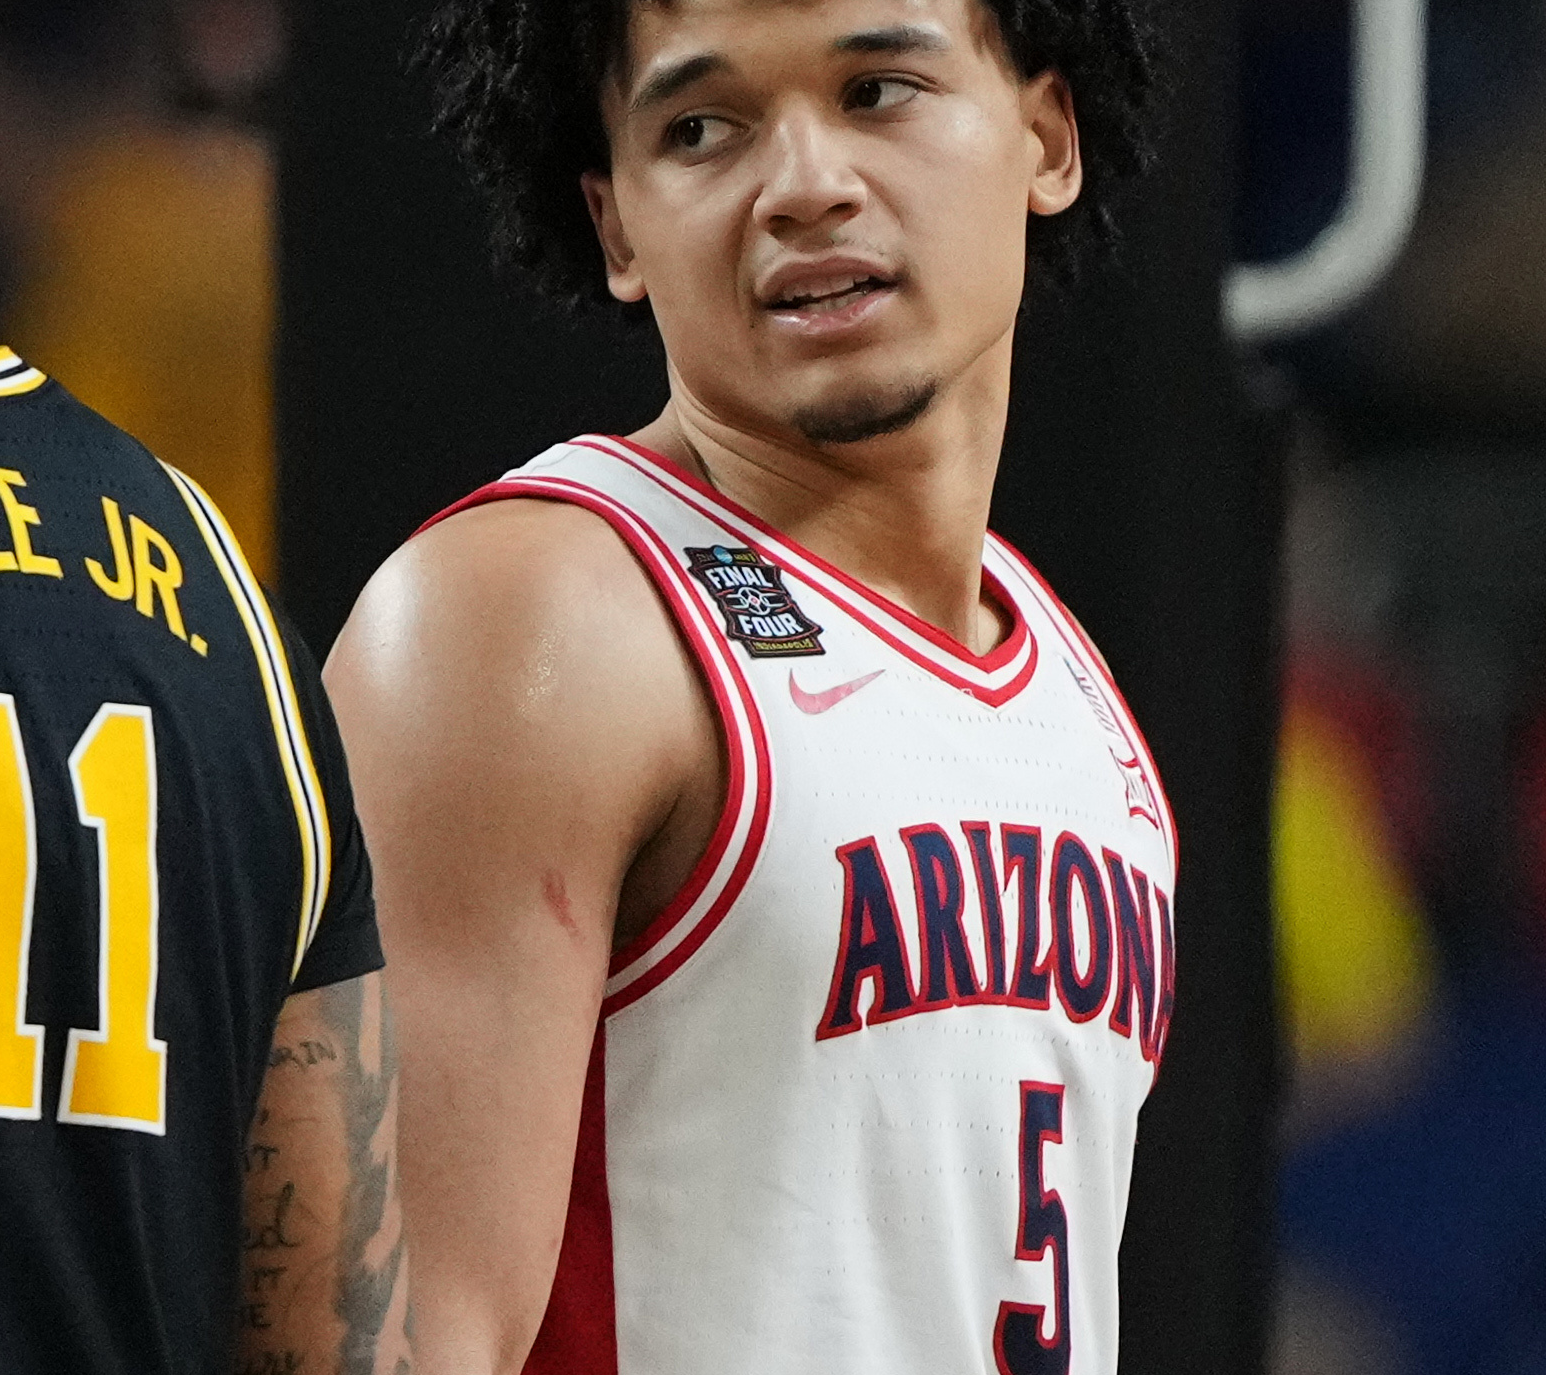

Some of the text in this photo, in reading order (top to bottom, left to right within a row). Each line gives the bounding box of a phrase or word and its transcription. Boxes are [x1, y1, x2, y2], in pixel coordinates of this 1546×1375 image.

[83, 496, 210, 657] JR.
[704, 566, 774, 590] FINAL
[737, 612, 805, 637] FOUR
